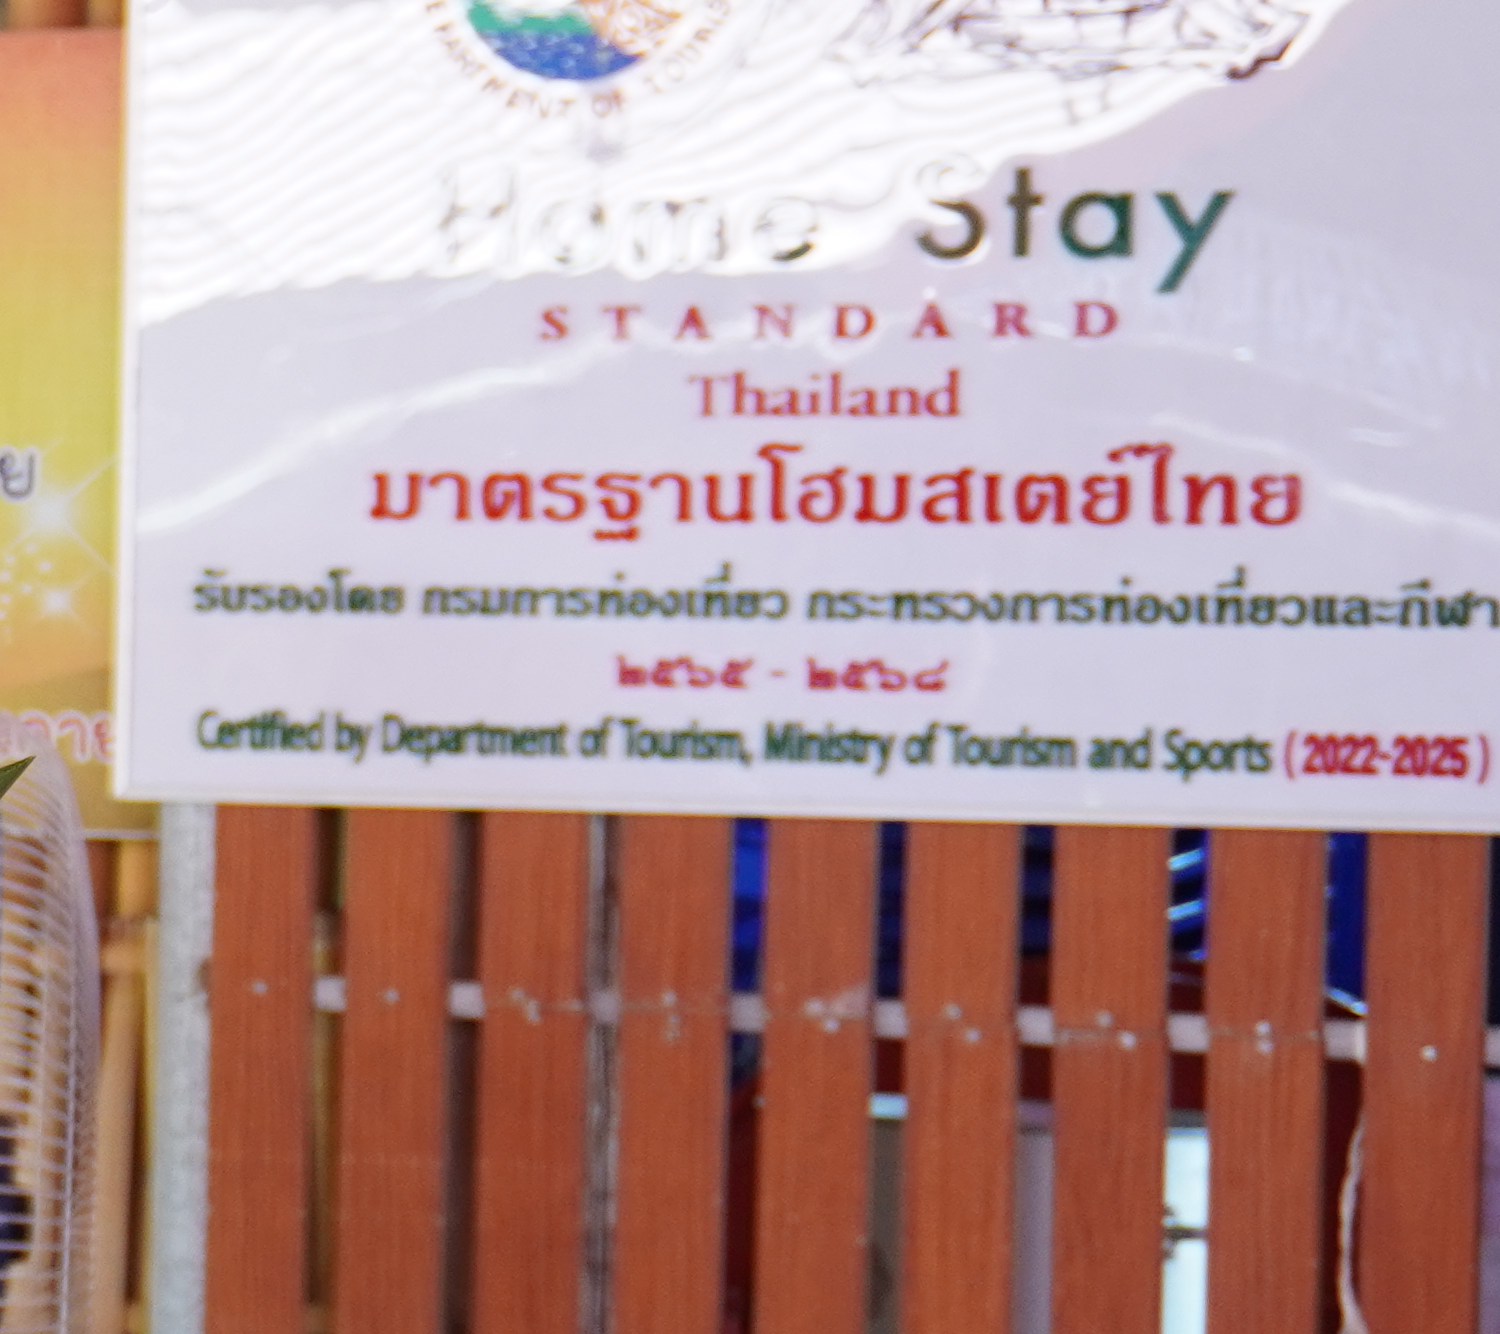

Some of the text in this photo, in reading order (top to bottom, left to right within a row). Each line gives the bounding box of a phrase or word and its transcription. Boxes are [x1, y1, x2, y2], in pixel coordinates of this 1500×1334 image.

[914, 157, 1237, 295] Stay
[539, 301, 1121, 343] STANDARD
[688, 369, 963, 420] Thailand
[370, 442, 1303, 543] มาตรฐานโฮมสเตย์ไทย
[193, 563, 1500, 627] รับรองโดย กรมการท่องเที่ยว กระทรวงการท่องเที่ยวและกีฬา
[198, 709, 327, 752] Certified
[334, 712, 372, 763] by
[383, 714, 567, 764] Department
[580, 716, 617, 757] of
[620, 718, 752, 768] Tourism,
[765, 720, 895, 775] Ministry
[905, 722, 941, 767] of
[946, 723, 1077, 769] Tourism
[1088, 727, 1152, 772] and
[1164, 728, 1273, 782] Sports
